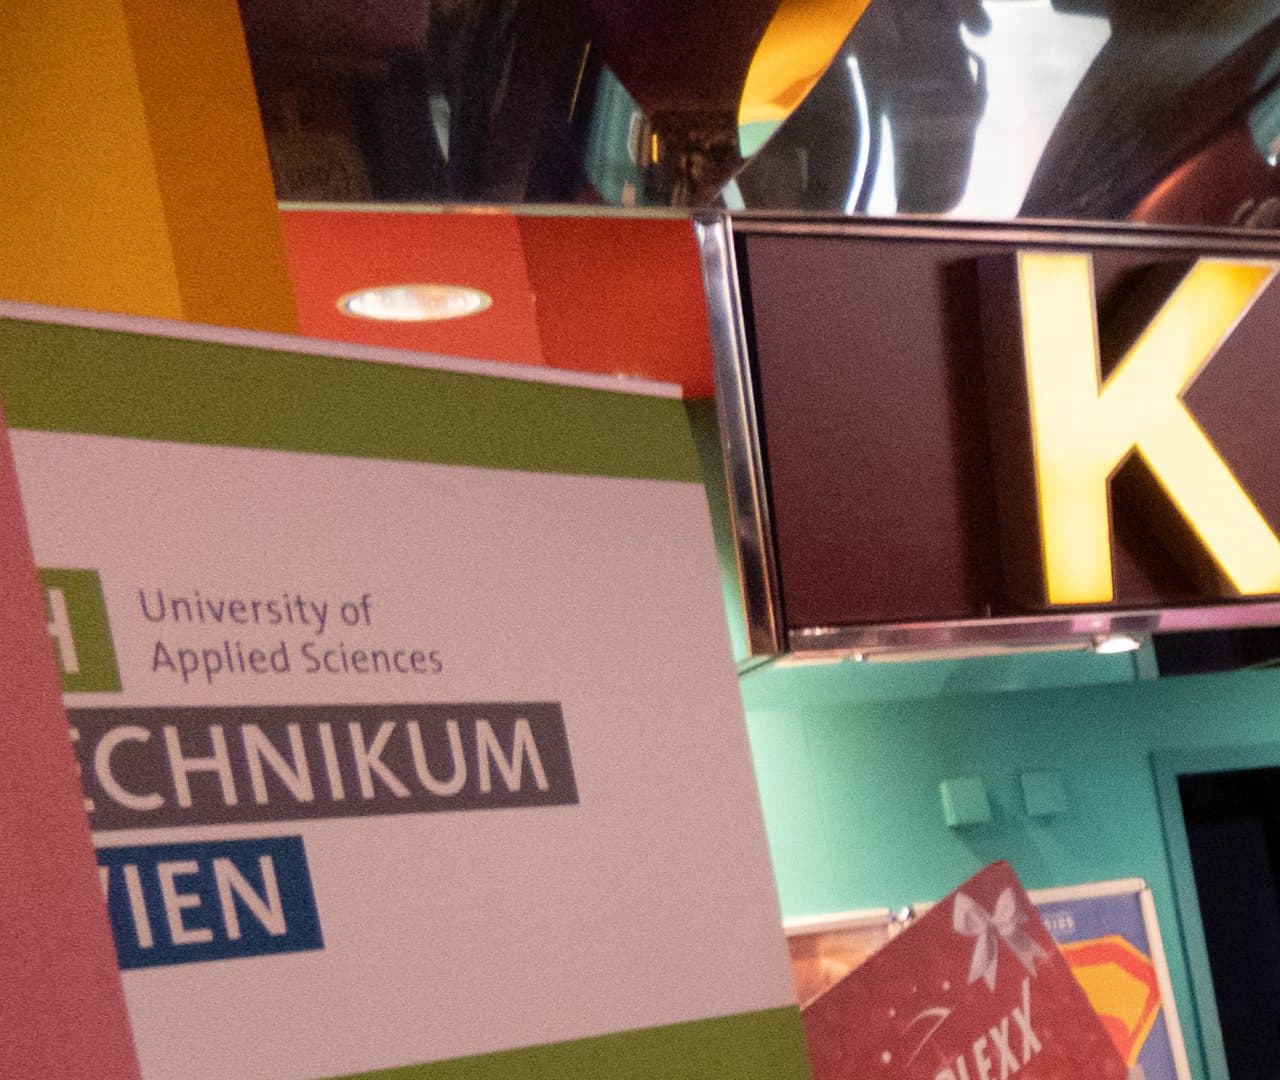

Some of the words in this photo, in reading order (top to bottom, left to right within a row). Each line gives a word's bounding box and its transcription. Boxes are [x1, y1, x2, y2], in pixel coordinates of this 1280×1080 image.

[138, 589, 328, 633] University
[341, 594, 373, 624] of
[151, 641, 290, 682] Applied
[301, 641, 444, 674] Sciences
[70, 718, 549, 811] CHNIKUM
[98, 855, 287, 949] IEN
